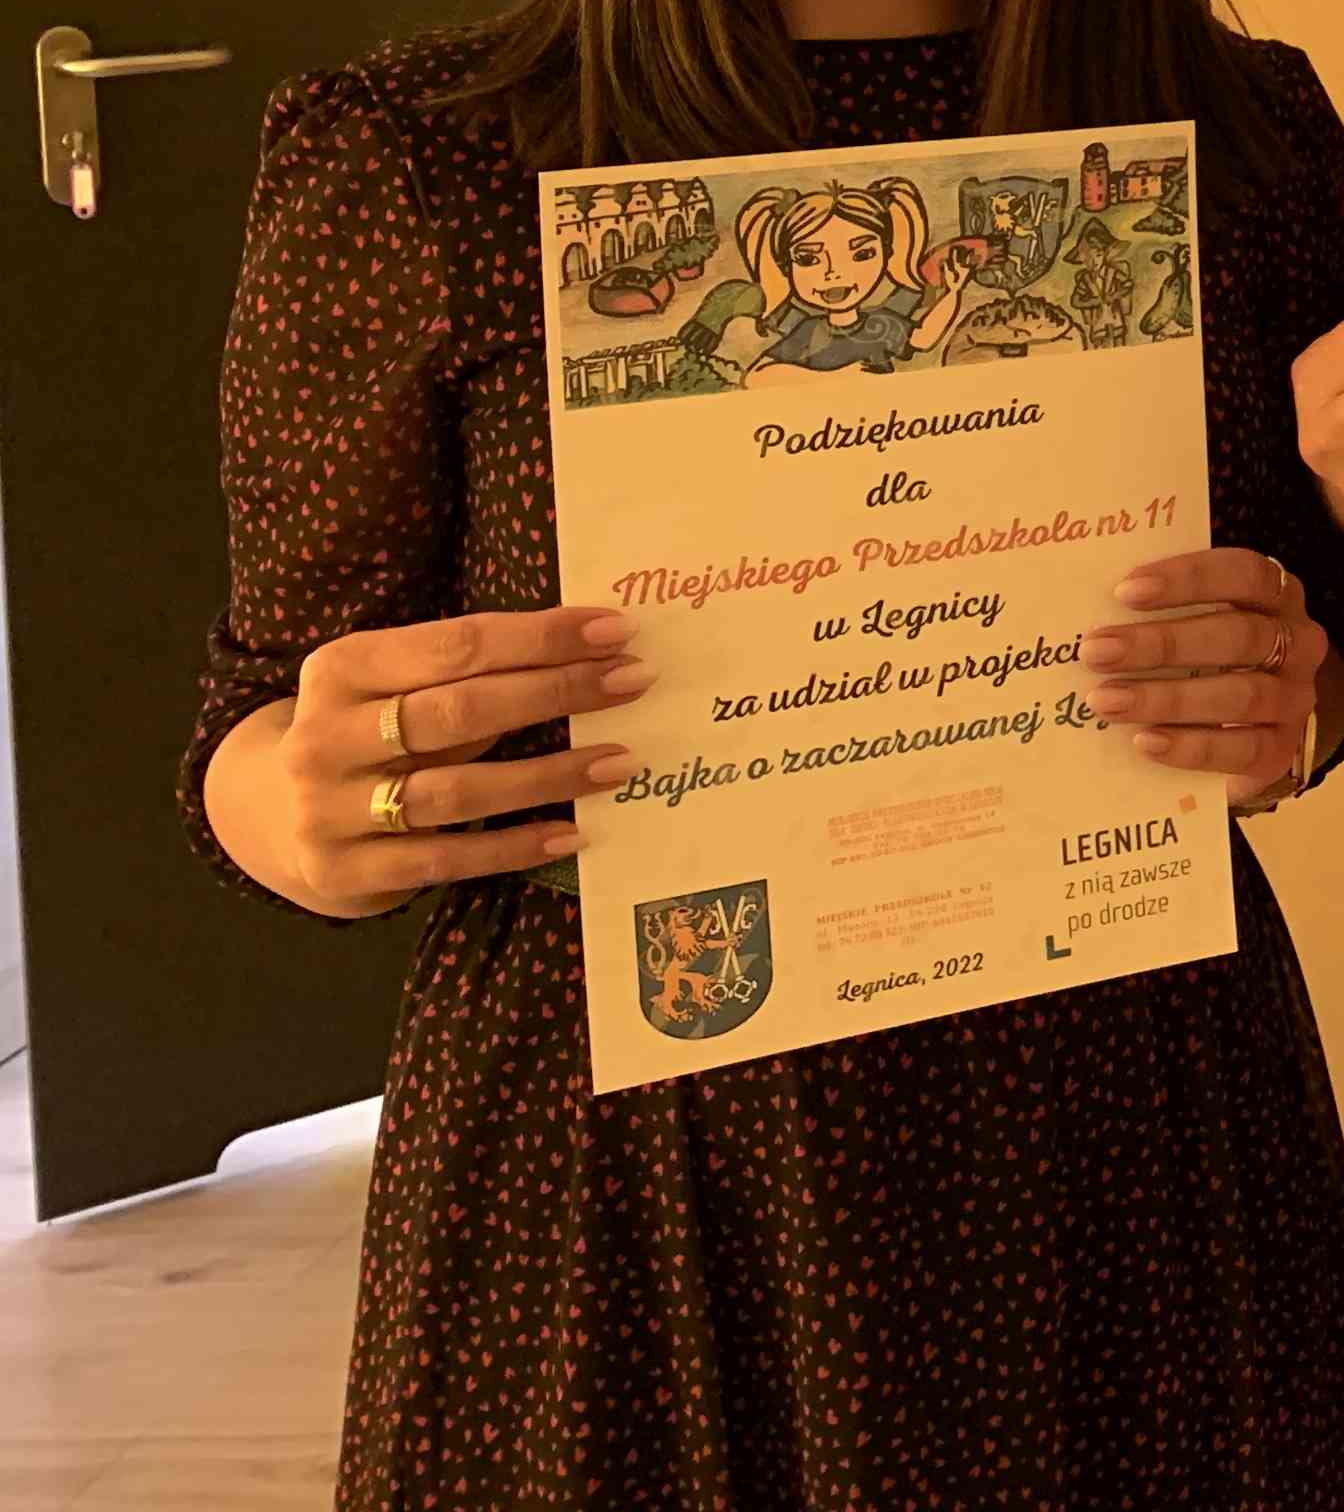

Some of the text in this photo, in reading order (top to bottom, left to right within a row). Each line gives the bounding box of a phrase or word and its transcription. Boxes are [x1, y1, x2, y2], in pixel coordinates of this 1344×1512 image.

[755, 398, 1046, 457] Podziękowania
[866, 471, 932, 508] dla
[613, 496, 1177, 609] Miejskiego Przedszkola nr 11
[813, 589, 1007, 642] w Legnicy
[712, 633, 1084, 722] za udział w projekci
[615, 757, 740, 806] Bajka
[747, 756, 774, 780] o
[781, 701, 1044, 774] zaczarowanej
[1061, 817, 1179, 865] LEGNICA
[1065, 857, 1192, 899] z nią zawsze
[1068, 894, 1169, 938] po drodze
[838, 953, 985, 1001] Legnica, 2022
